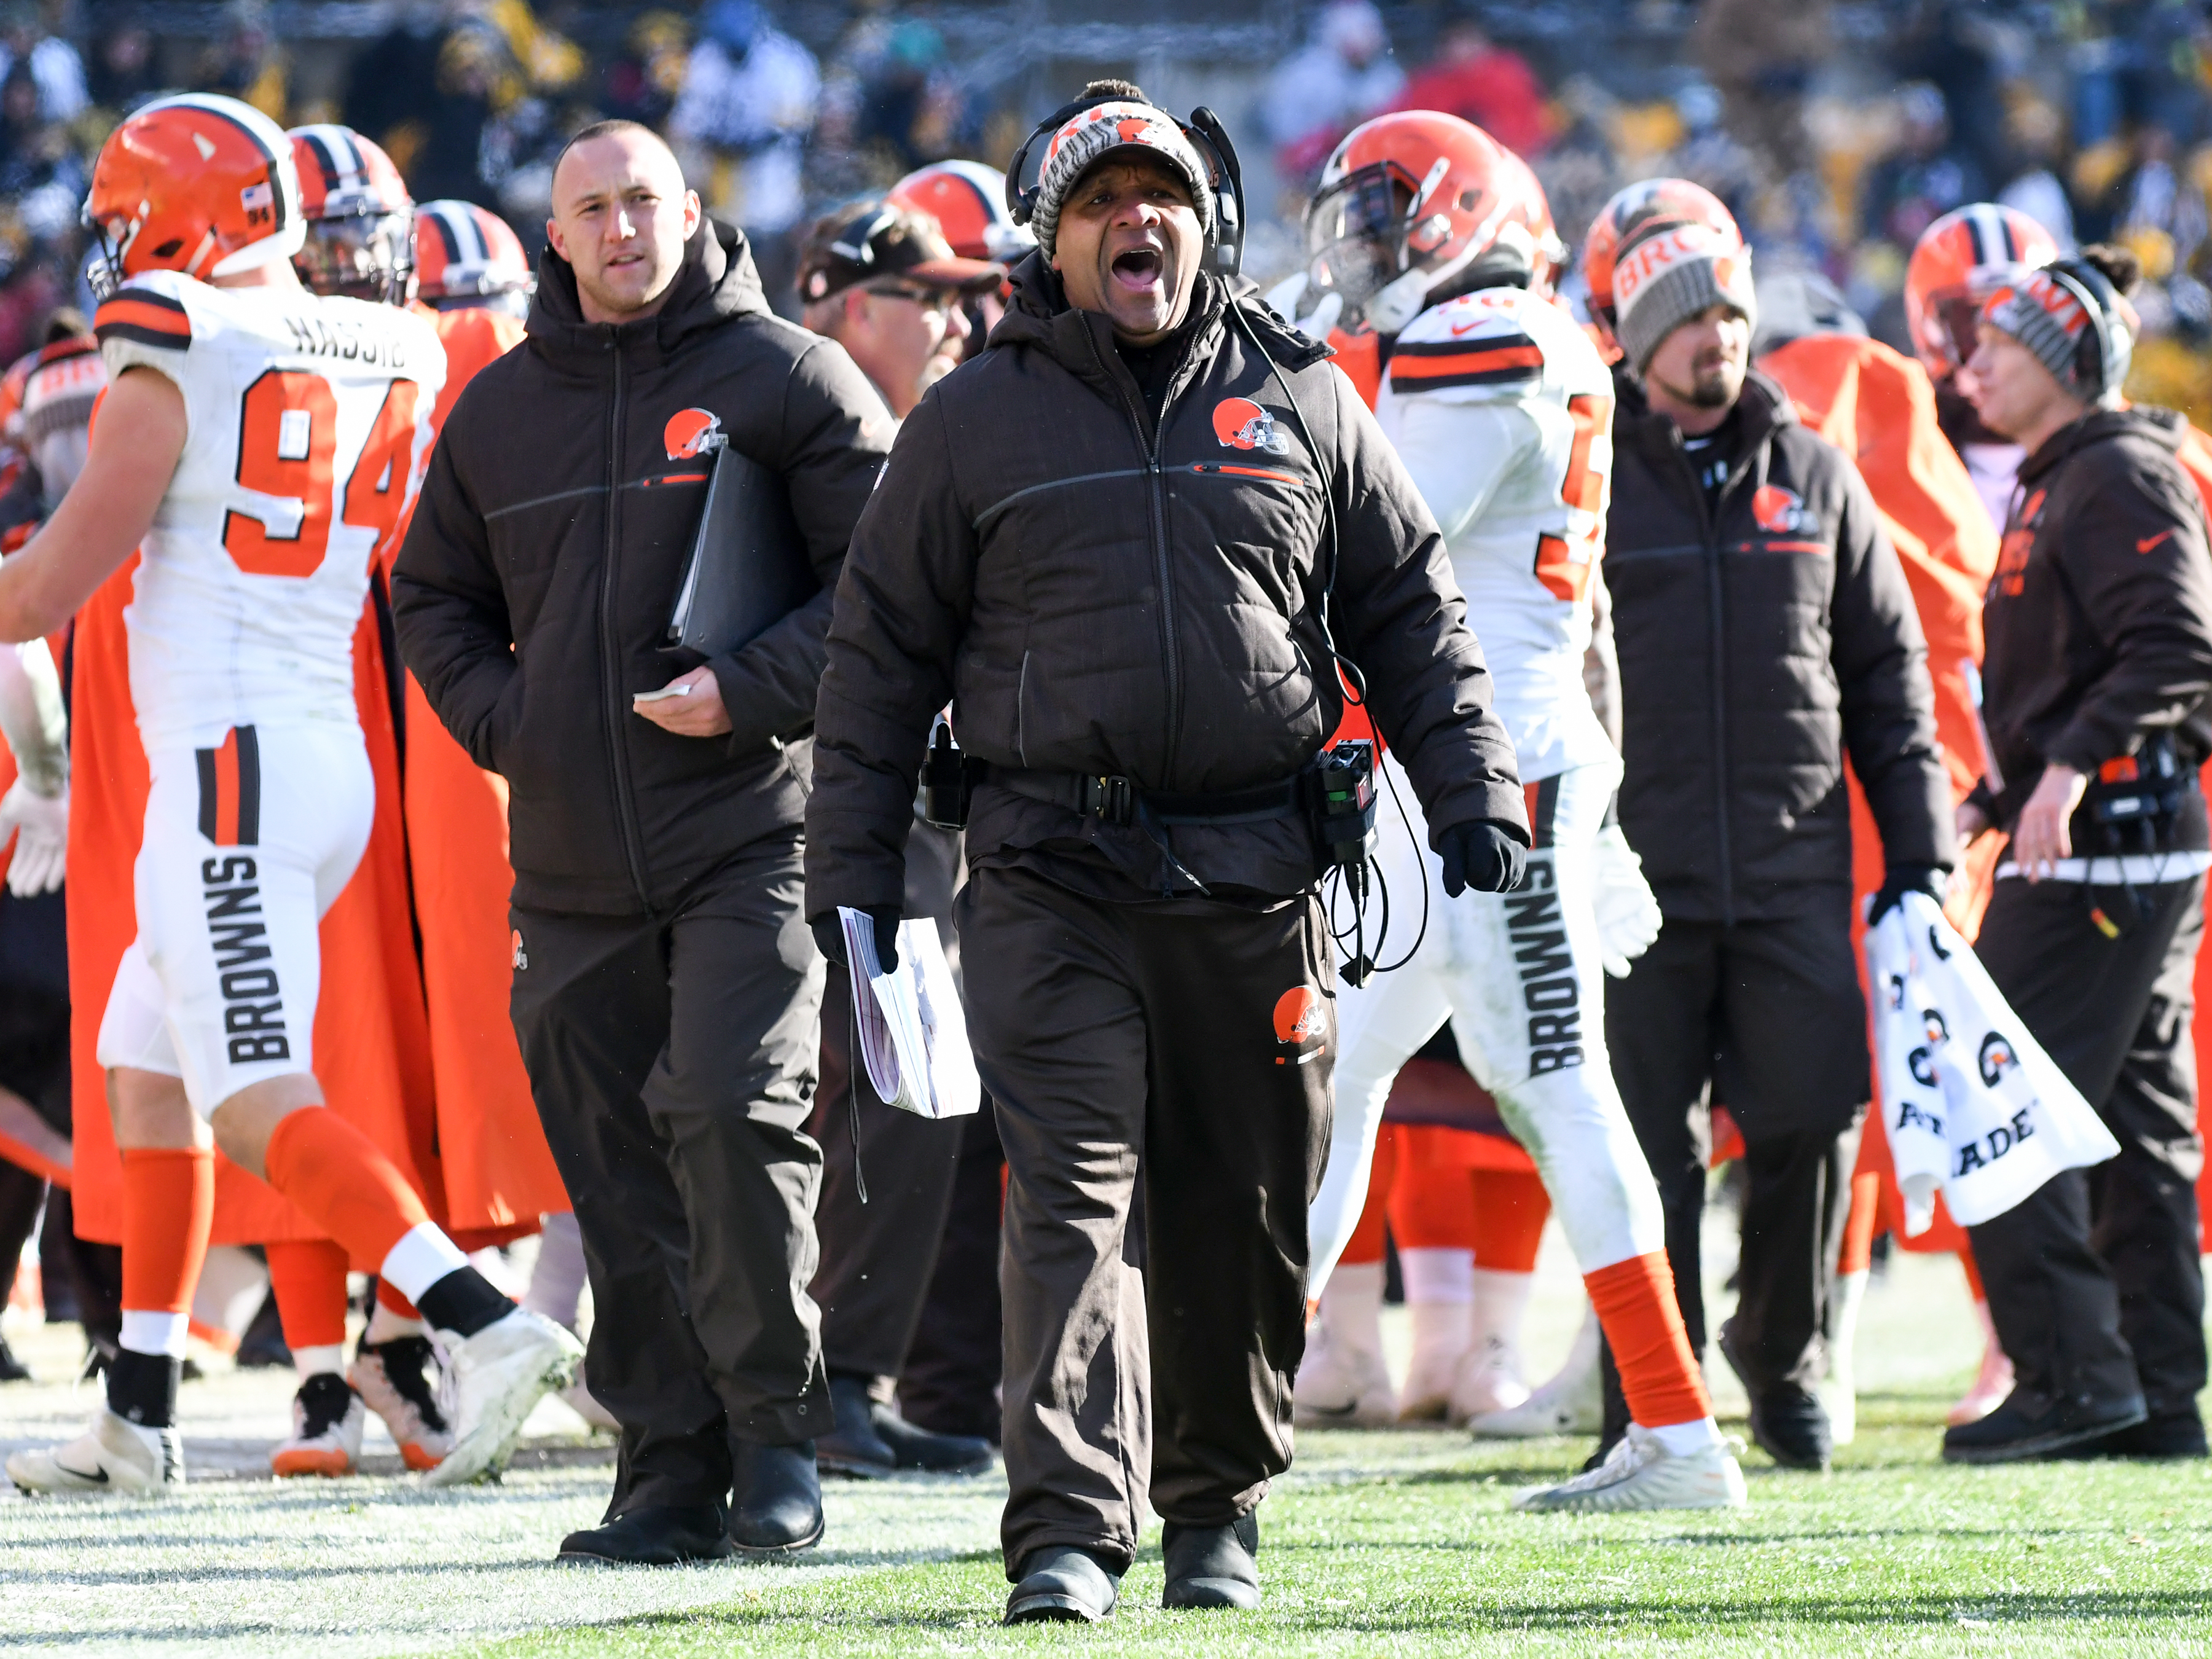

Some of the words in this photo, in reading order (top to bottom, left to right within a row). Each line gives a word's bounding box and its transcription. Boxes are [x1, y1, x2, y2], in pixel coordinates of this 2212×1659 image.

[220, 366, 420, 579] 94
[202, 856, 291, 1064] BROWNS
[1504, 860, 1586, 1080] BROWNS
